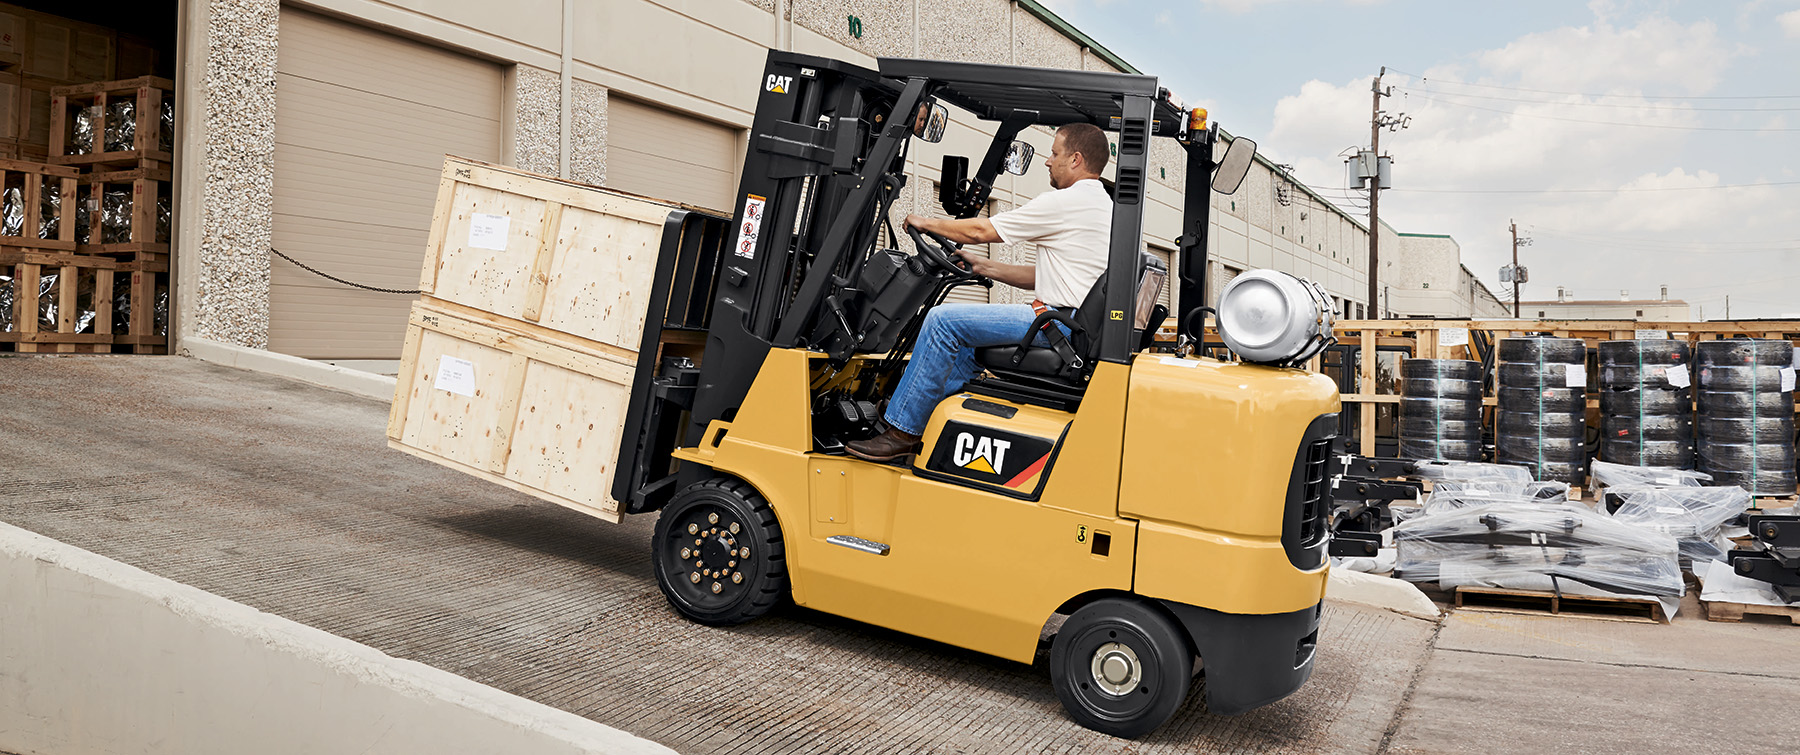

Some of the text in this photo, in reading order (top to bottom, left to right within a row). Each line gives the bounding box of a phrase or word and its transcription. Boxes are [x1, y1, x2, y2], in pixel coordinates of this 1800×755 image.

[848, 15, 862, 38] 10
[766, 74, 793, 94] CAT
[953, 432, 1011, 475] CAT
